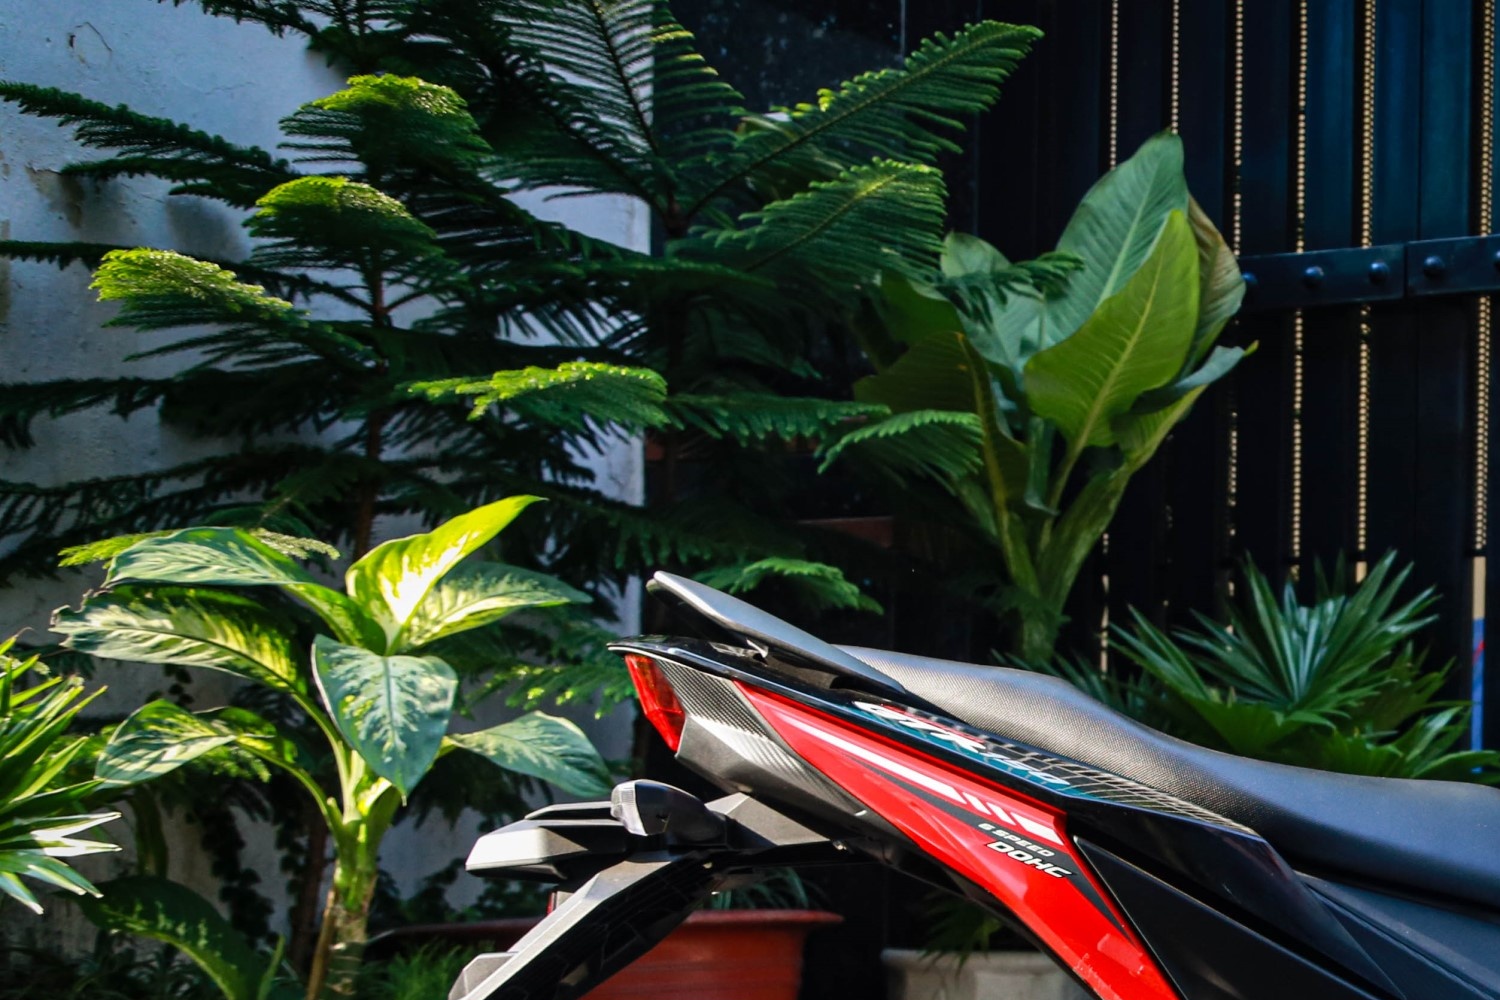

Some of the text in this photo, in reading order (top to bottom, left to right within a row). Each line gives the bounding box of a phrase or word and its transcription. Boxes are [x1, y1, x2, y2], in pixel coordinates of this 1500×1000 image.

[853, 701, 987, 753] GTR
[986, 841, 1073, 878] DOHC
[992, 829, 1055, 857] SPEED
